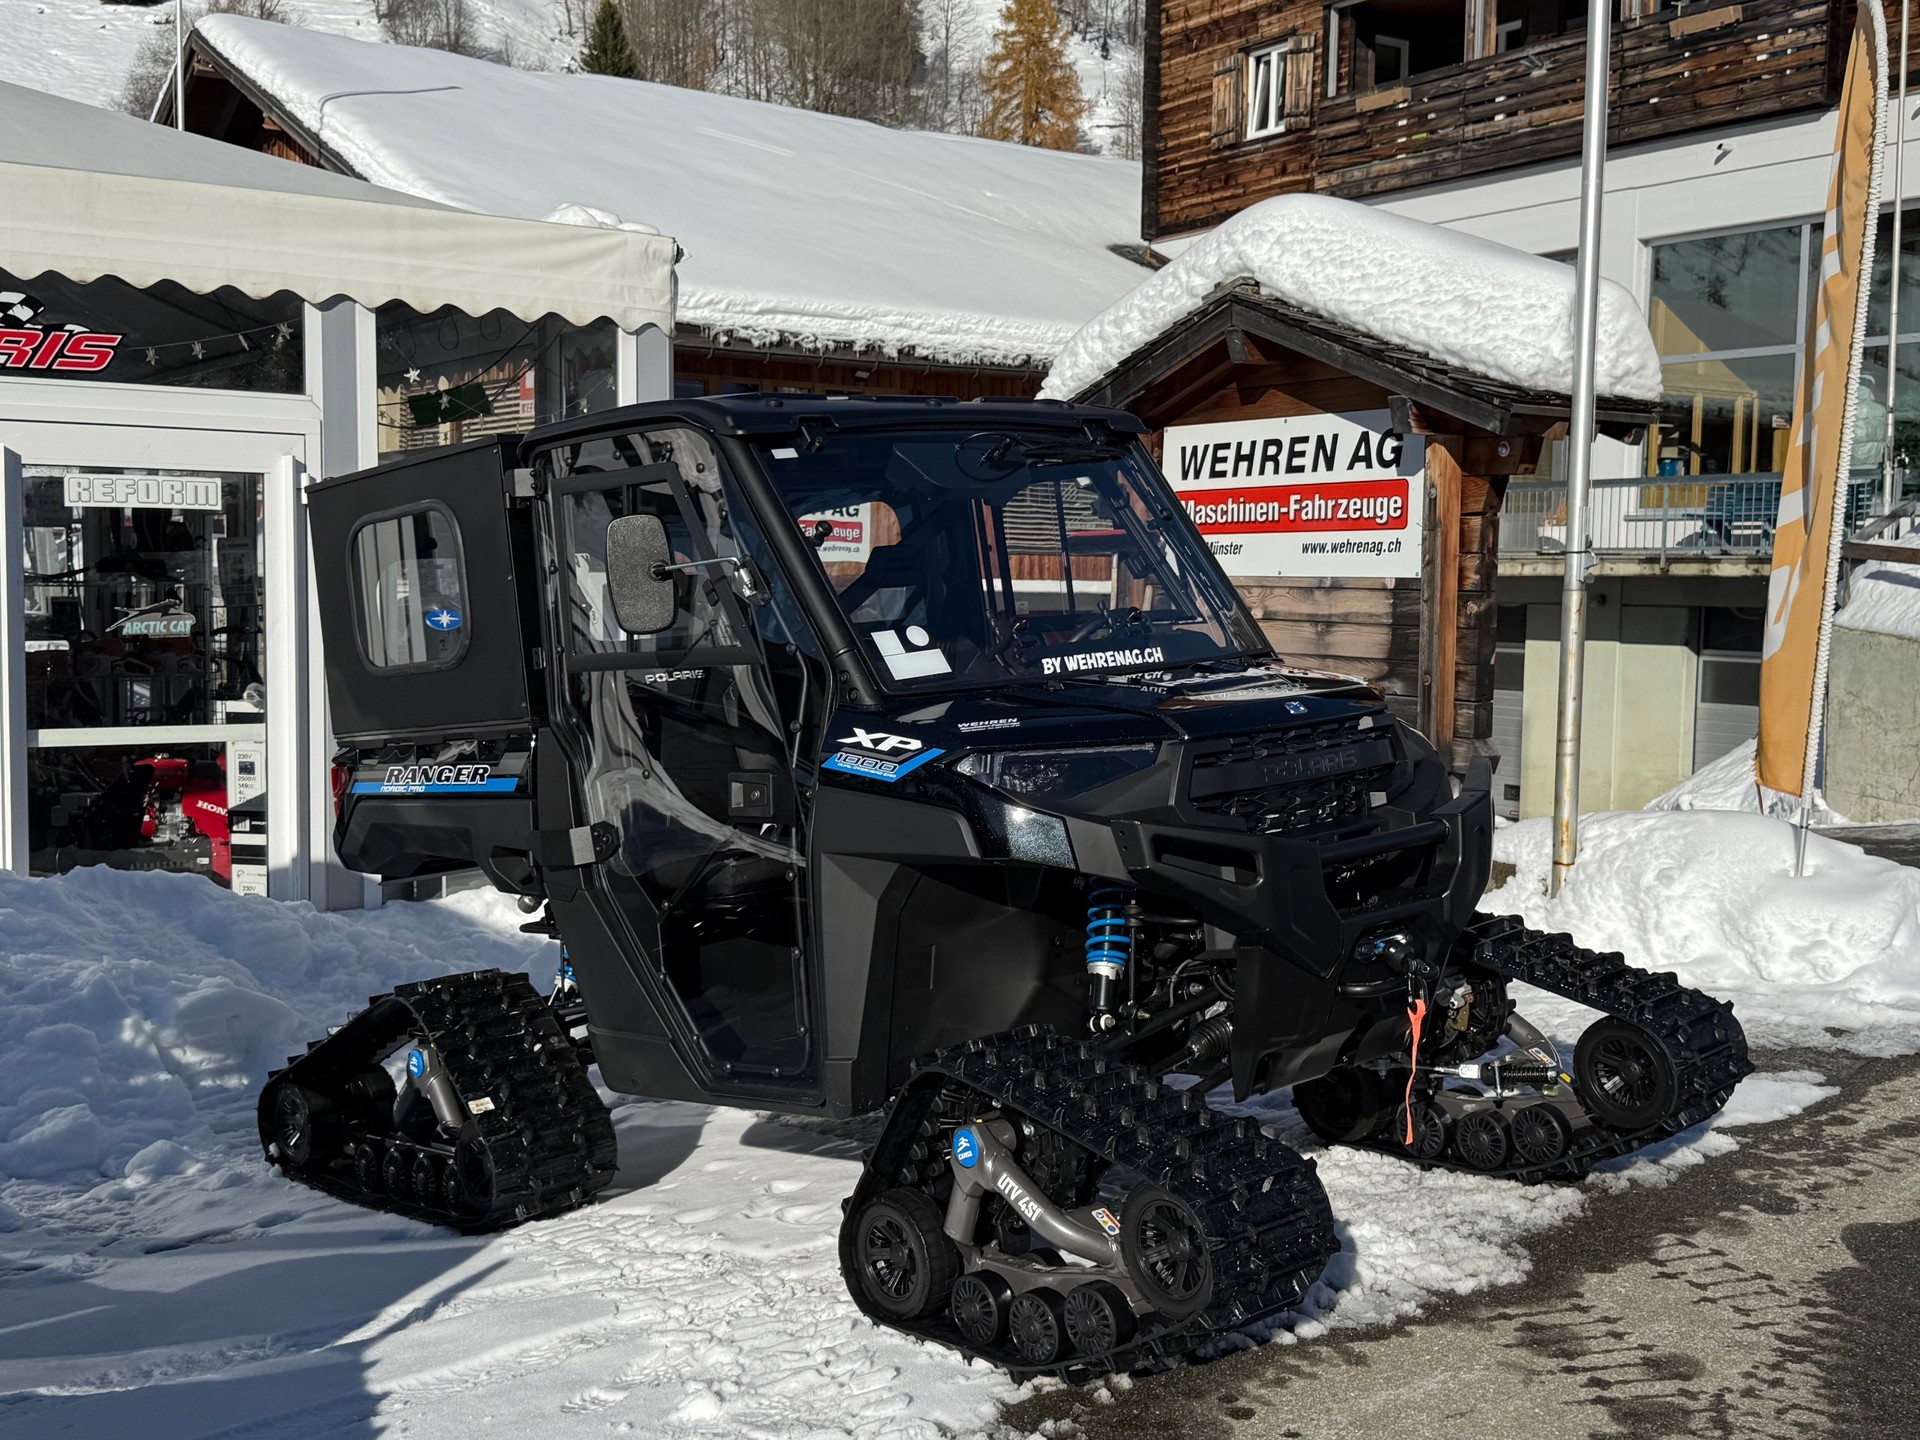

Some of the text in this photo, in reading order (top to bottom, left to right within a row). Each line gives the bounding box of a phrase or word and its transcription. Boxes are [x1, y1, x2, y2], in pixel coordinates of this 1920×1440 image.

[1180, 428, 1404, 481] WEHREN AG
[67, 477, 219, 507] REFORM
[1182, 494, 1403, 526] Maschinen-Fahrzeuge
[1301, 538, 1402, 557] www.wehrenag.ch
[122, 620, 193, 636] ARCTIC CAT
[1041, 647, 1164, 675] BY WEHRENAG.CH
[644, 669, 705, 685] POLARIS
[957, 717, 1018, 728] WEHREN
[836, 727, 923, 752] XP
[835, 752, 899, 774] 1000
[1260, 747, 1358, 784] POLARIS
[384, 764, 491, 786] RANGER
[380, 785, 426, 793] NORDIC PRO
[196, 799, 228, 817] HON
[996, 1173, 1023, 1202] UTV
